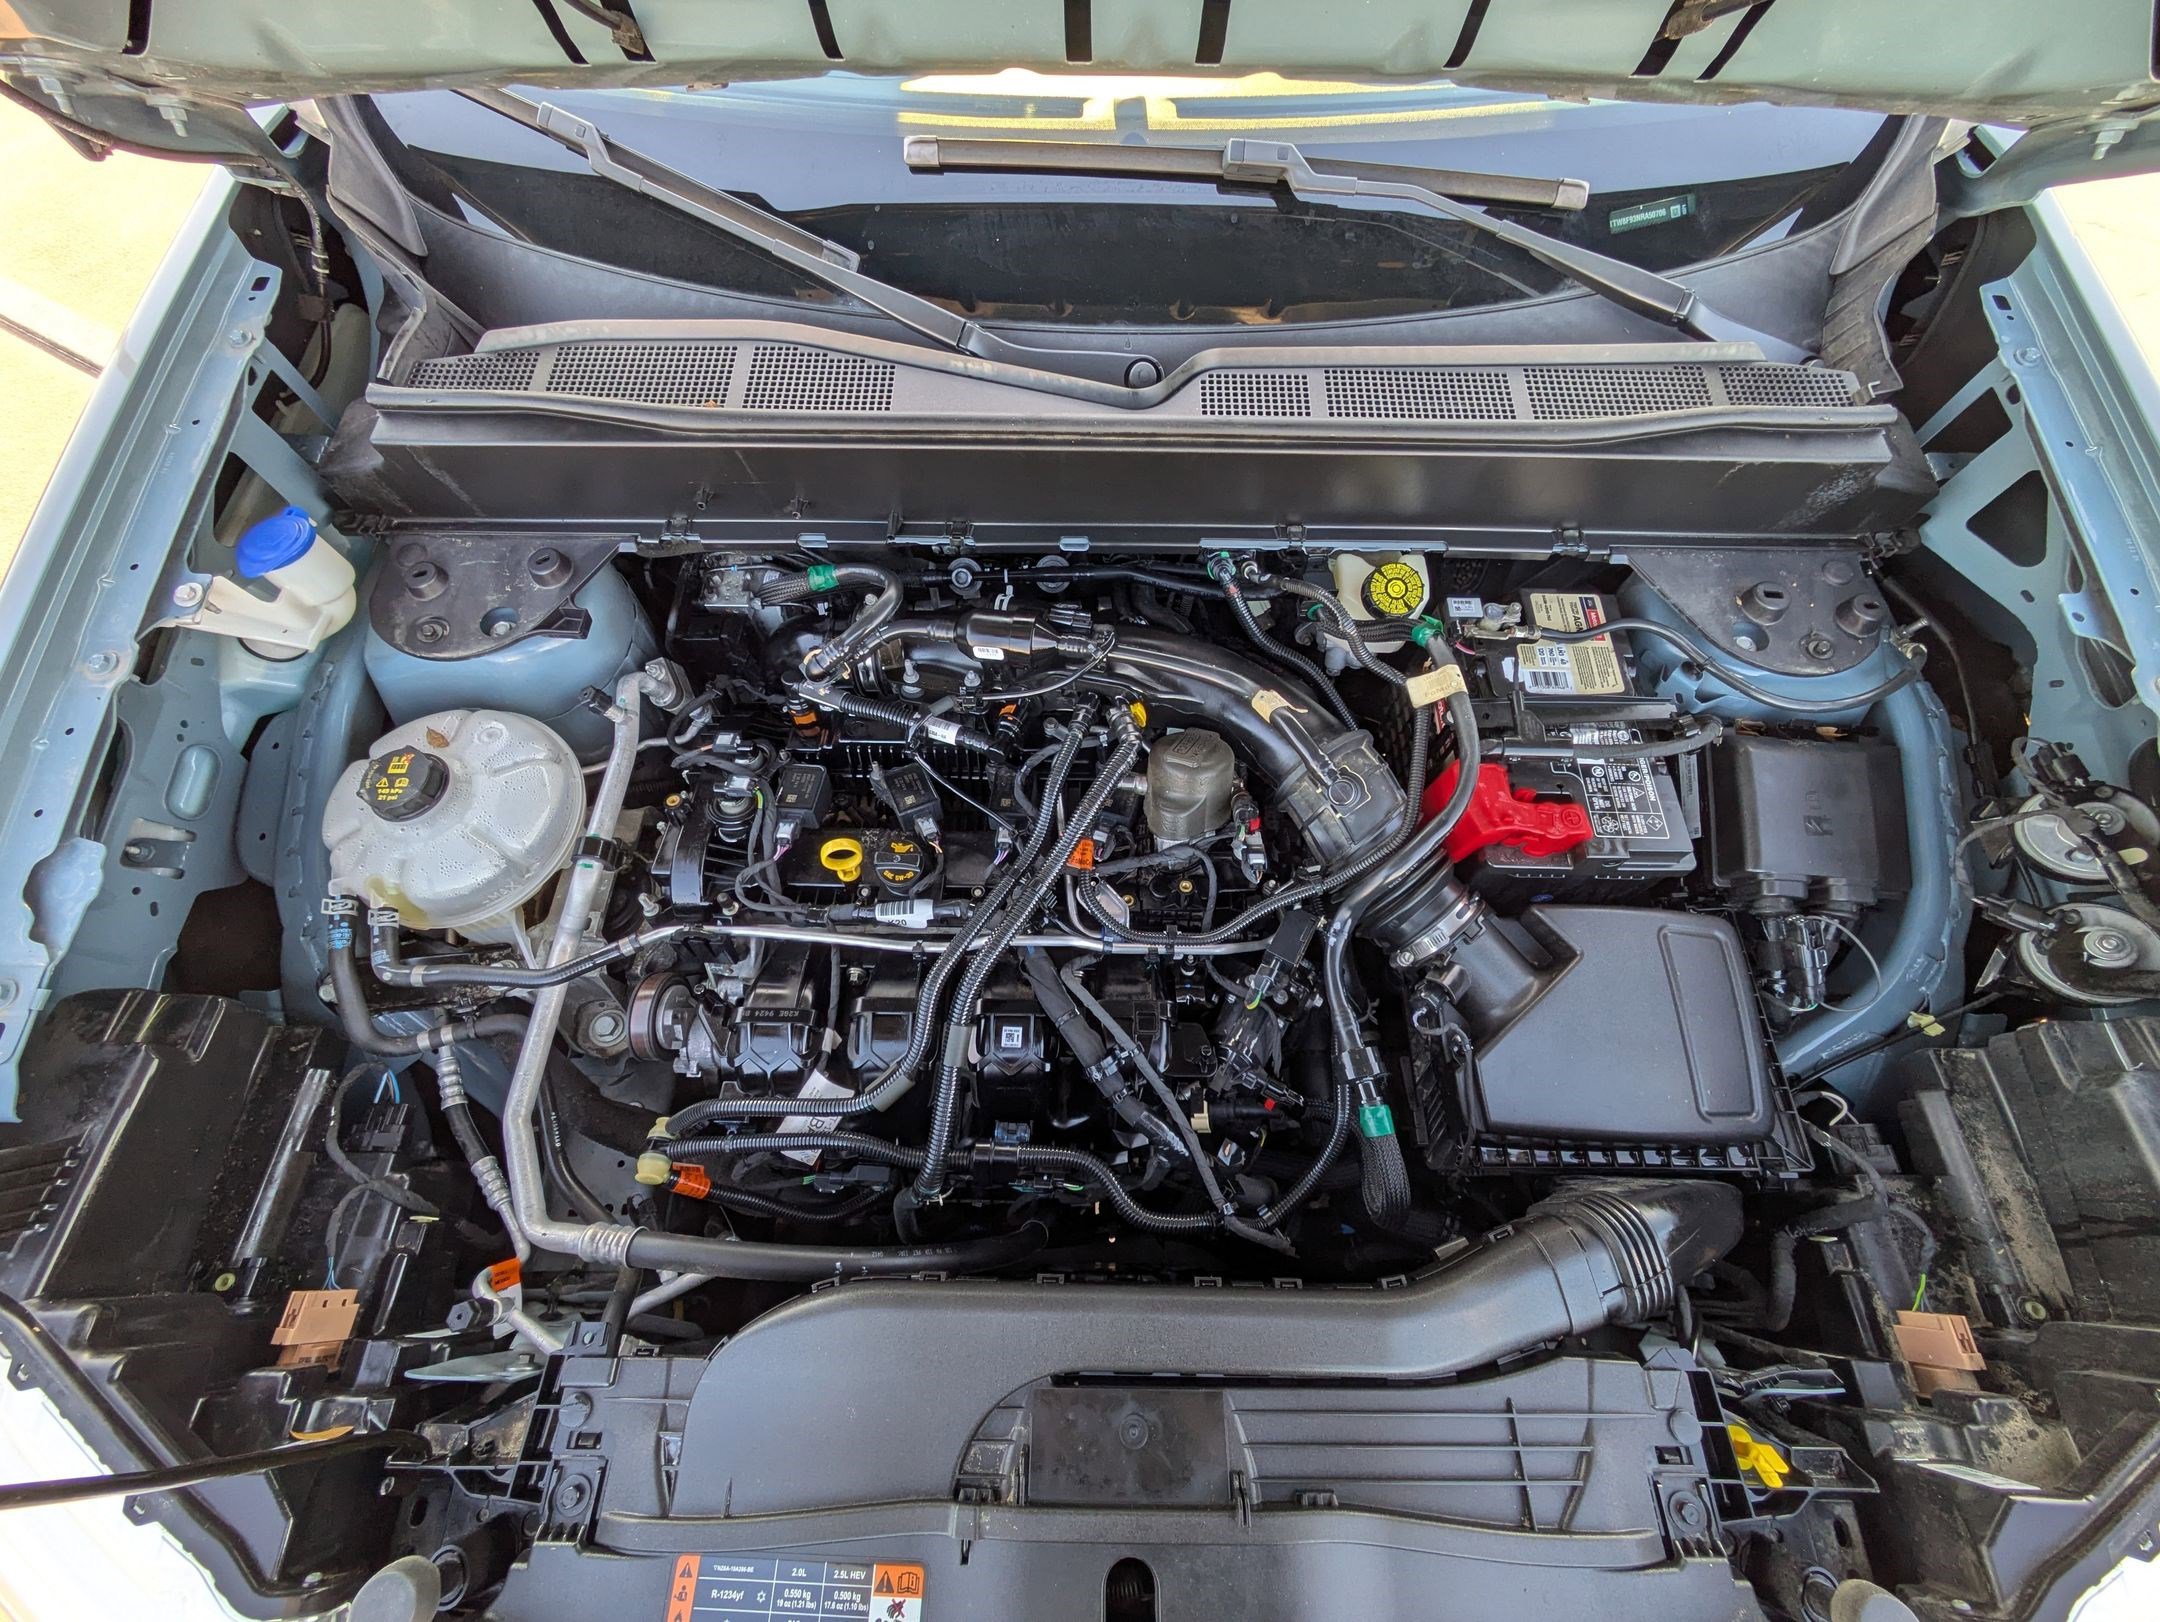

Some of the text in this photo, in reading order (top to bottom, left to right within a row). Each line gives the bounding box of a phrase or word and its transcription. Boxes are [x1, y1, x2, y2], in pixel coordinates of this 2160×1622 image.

[792, 1568, 807, 1577] 2.0L
[834, 1570, 866, 1580] 2.5L HEV
[711, 1589, 744, 1602] R-1234yf
[784, 1588, 811, 1600] 0.550 kg
[834, 1590, 861, 1603] 0.500 kg
[776, 1599, 783, 1607] 19
[792, 1600, 805, 1609] (1.21
[806, 1601, 816, 1610] lbs)
